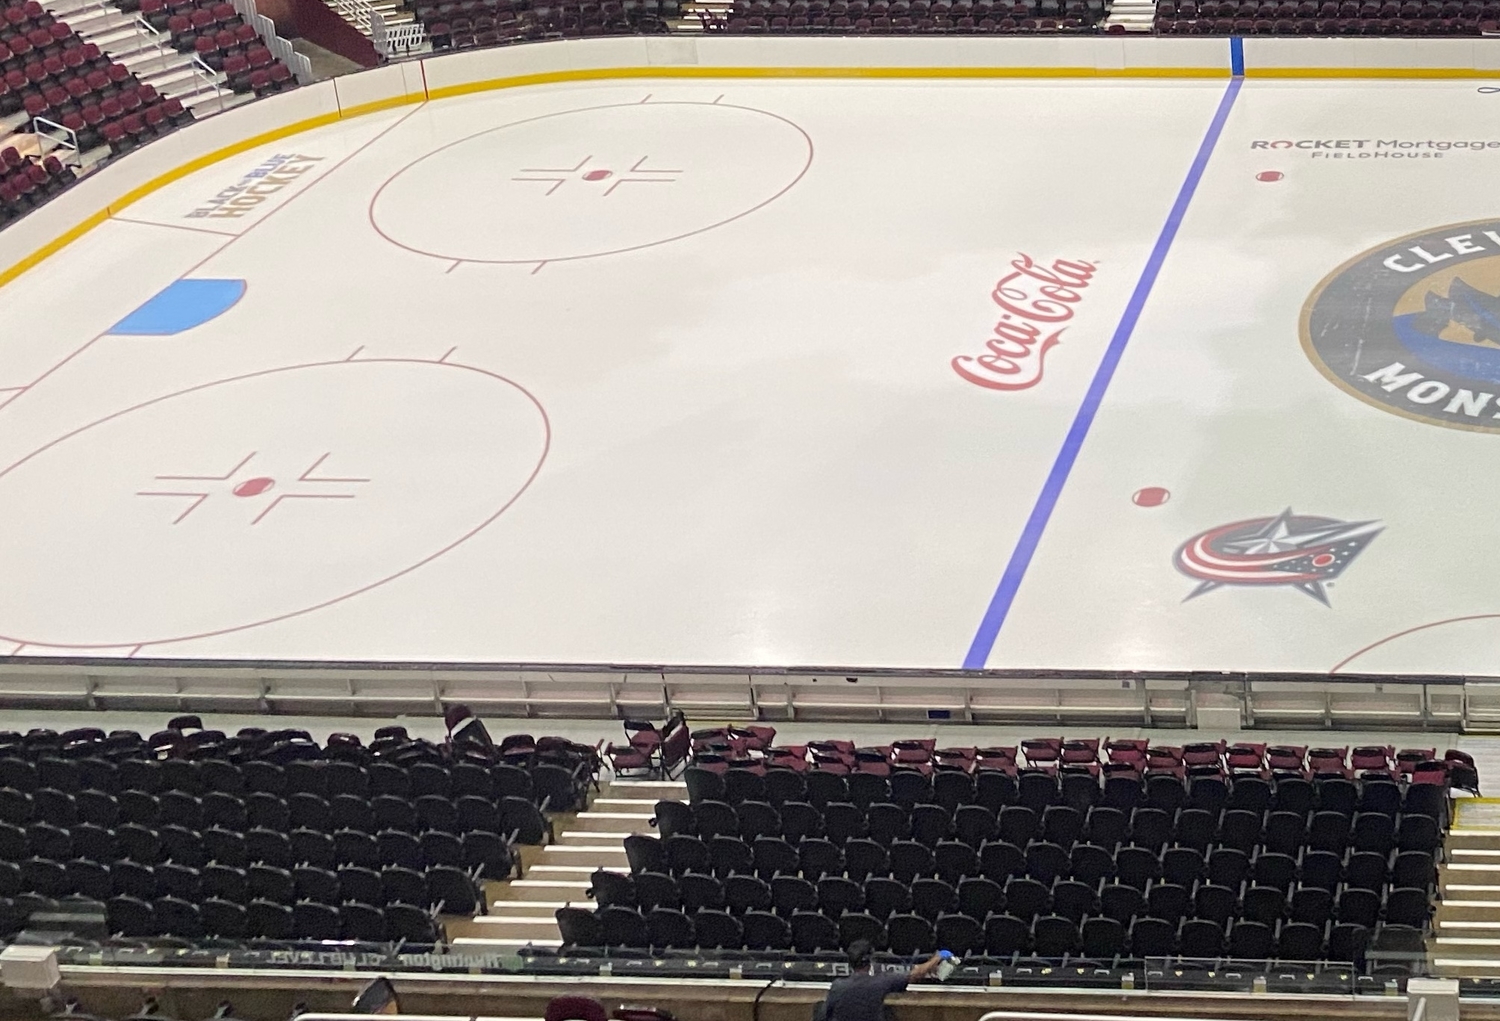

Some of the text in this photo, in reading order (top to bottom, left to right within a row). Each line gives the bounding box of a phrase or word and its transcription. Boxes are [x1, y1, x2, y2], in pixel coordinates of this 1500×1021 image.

[1250, 139, 1371, 150] ROCKET
[208, 154, 325, 218] HOCKEY
[951, 250, 1098, 392] Coca-Cola
